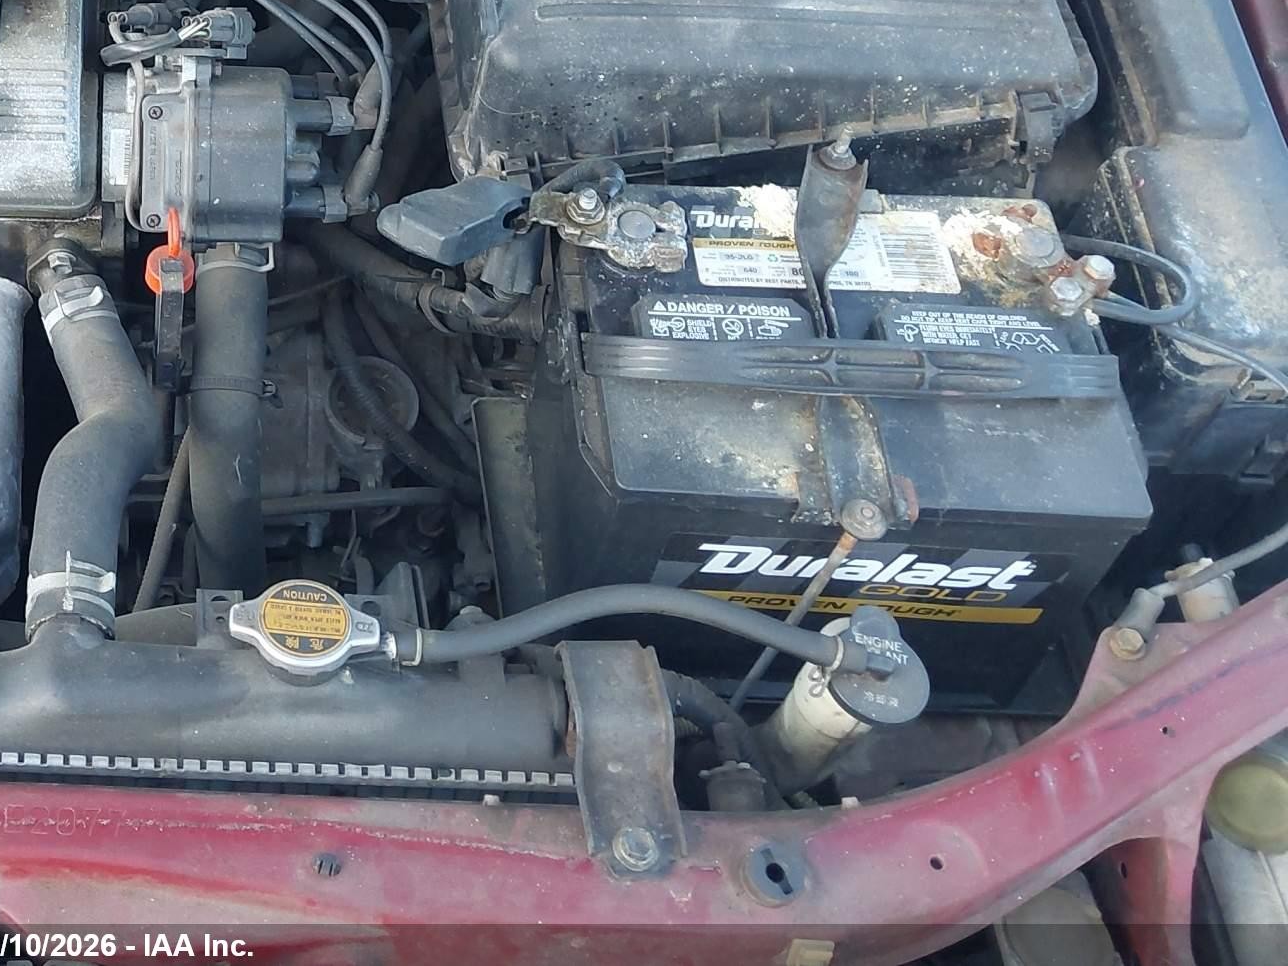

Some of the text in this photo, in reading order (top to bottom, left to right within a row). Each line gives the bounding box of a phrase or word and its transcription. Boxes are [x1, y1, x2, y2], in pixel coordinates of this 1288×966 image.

[666, 301, 724, 315] DANGER
[738, 306, 790, 317] POISON
[672, 332, 710, 340] EXPLOSIVE
[697, 542, 1037, 591] Duralast
[283, 589, 328, 603] CAUTION
[858, 584, 1009, 603] GOLD
[727, 595, 848, 611] PRON
[854, 633, 904, 652] ENGINE
